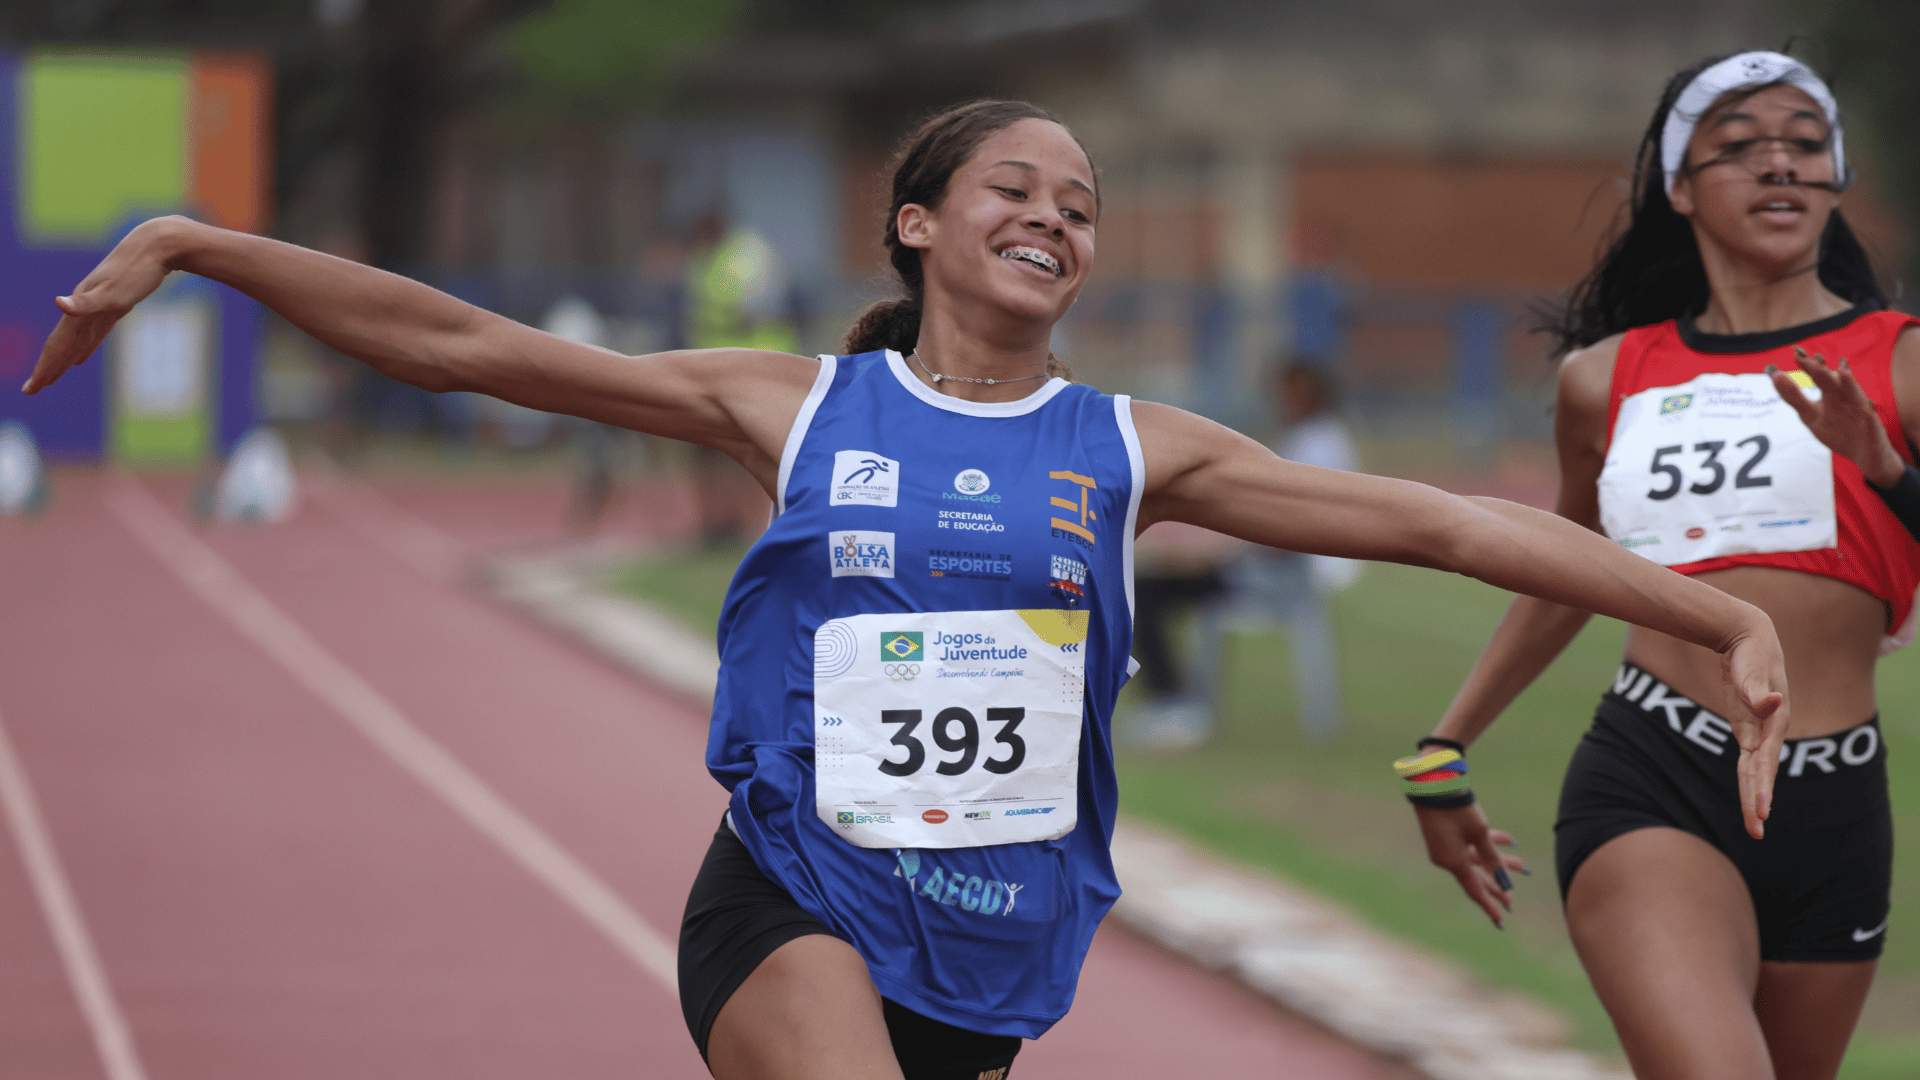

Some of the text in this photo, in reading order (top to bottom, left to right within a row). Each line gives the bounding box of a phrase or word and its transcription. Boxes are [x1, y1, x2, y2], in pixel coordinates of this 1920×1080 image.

[1646, 434, 1773, 502] 532
[942, 492, 1002, 503] Macaé
[938, 510, 994, 521] SECRETARIA
[938, 520, 1005, 533] DE EDUCAÇÃO
[1051, 528, 1095, 552] ETESCO
[929, 549, 992, 560] SECRETARIA
[835, 558, 890, 568] ATLETA
[928, 556, 1012, 575] ESPORTES
[933, 631, 996, 648] Jogos da
[940, 645, 1027, 661] Juventude
[1613, 664, 1733, 756] NIKE
[877, 706, 1027, 777] 393
[856, 815, 895, 824] BRASIL
